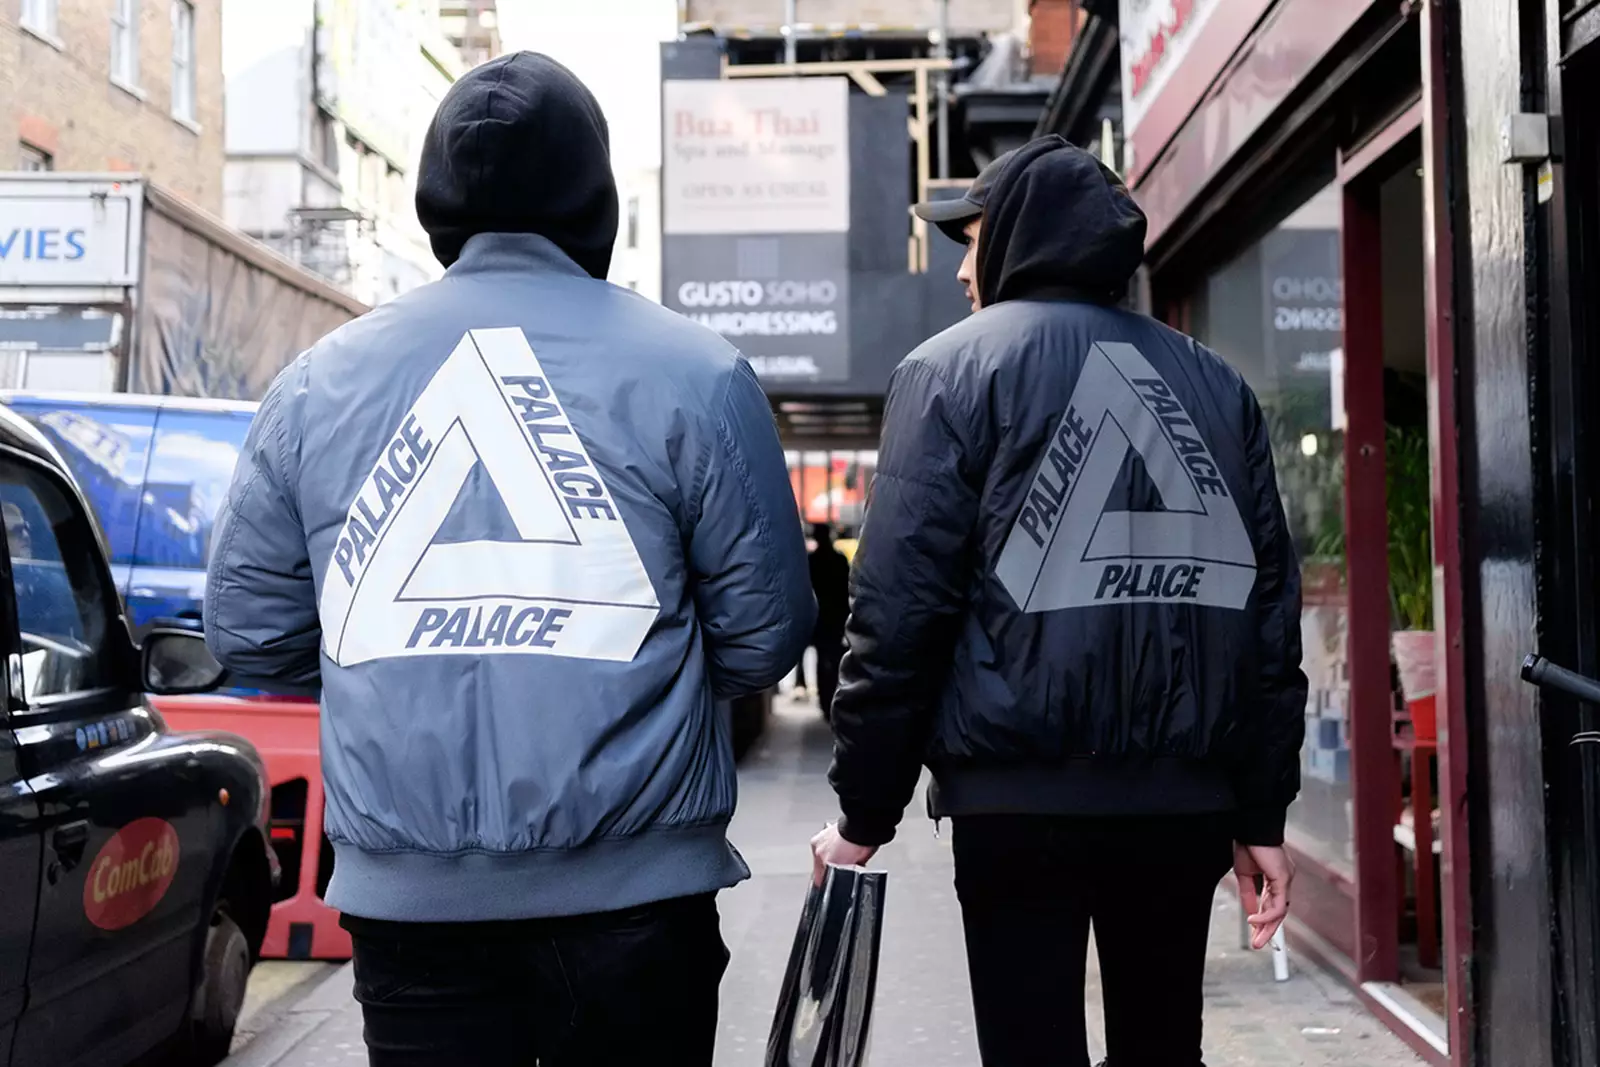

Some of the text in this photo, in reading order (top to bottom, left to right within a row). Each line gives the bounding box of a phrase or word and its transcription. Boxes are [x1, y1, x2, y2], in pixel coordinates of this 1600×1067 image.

[675, 107, 820, 137] Bua Thai
[678, 280, 837, 307] GUSTO SOHO
[500, 375, 618, 521] PALACE
[1131, 378, 1228, 498] PALACE
[334, 413, 433, 588] PALACE
[1019, 405, 1093, 549] PALACE
[1094, 564, 1205, 599] PALACE
[404, 605, 573, 649] PALACE
[93, 833, 173, 903] ComCab
